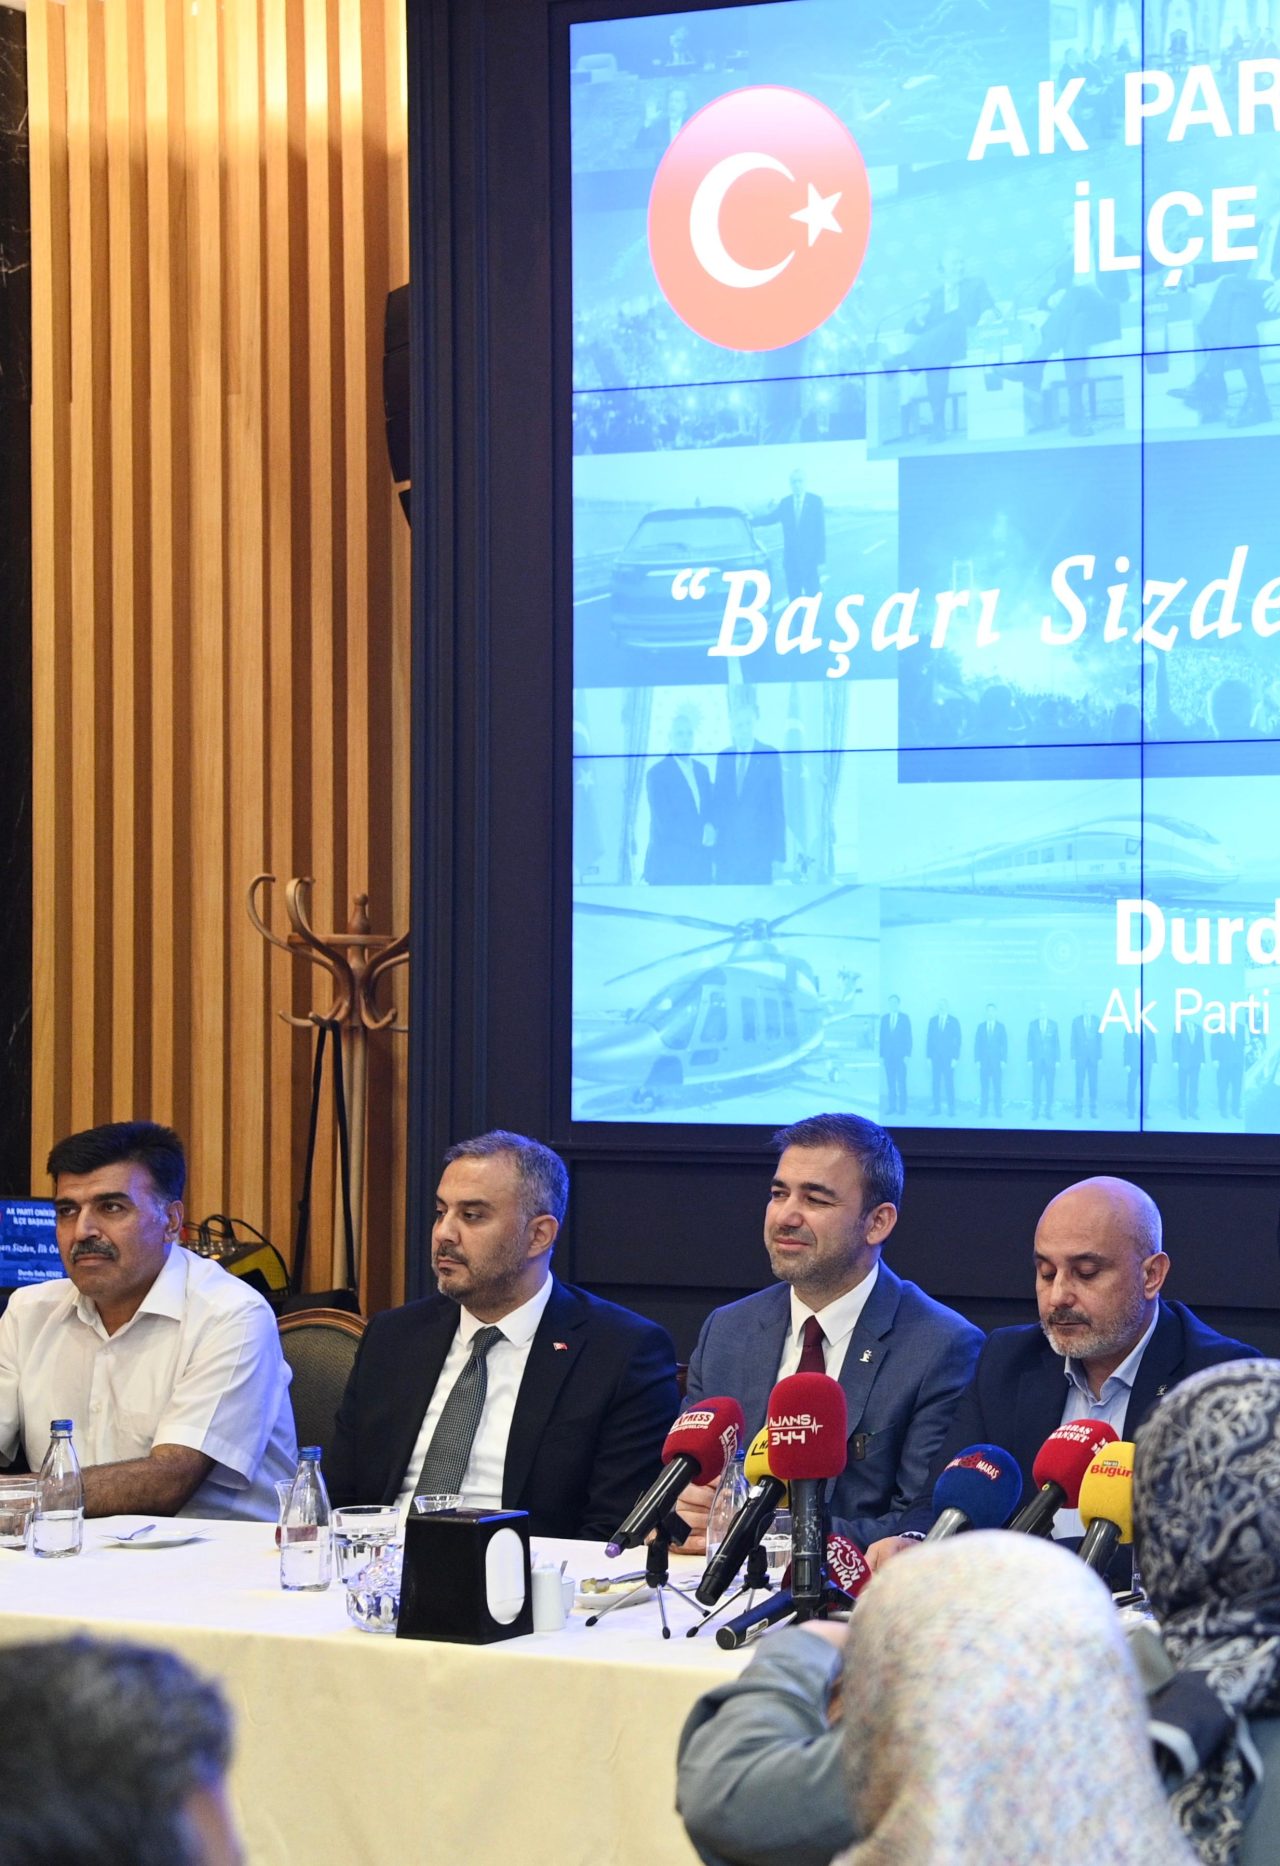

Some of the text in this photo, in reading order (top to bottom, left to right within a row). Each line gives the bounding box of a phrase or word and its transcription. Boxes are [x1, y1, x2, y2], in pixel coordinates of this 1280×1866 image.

[968, 77, 1088, 160] AK
[1074, 181, 1258, 286] İLÇE
[1099, 988, 1154, 1033] Ak
[1175, 988, 1269, 1034] Parti
[771, 1430, 806, 1446] 344
[827, 1550, 853, 1592] AKİKA
